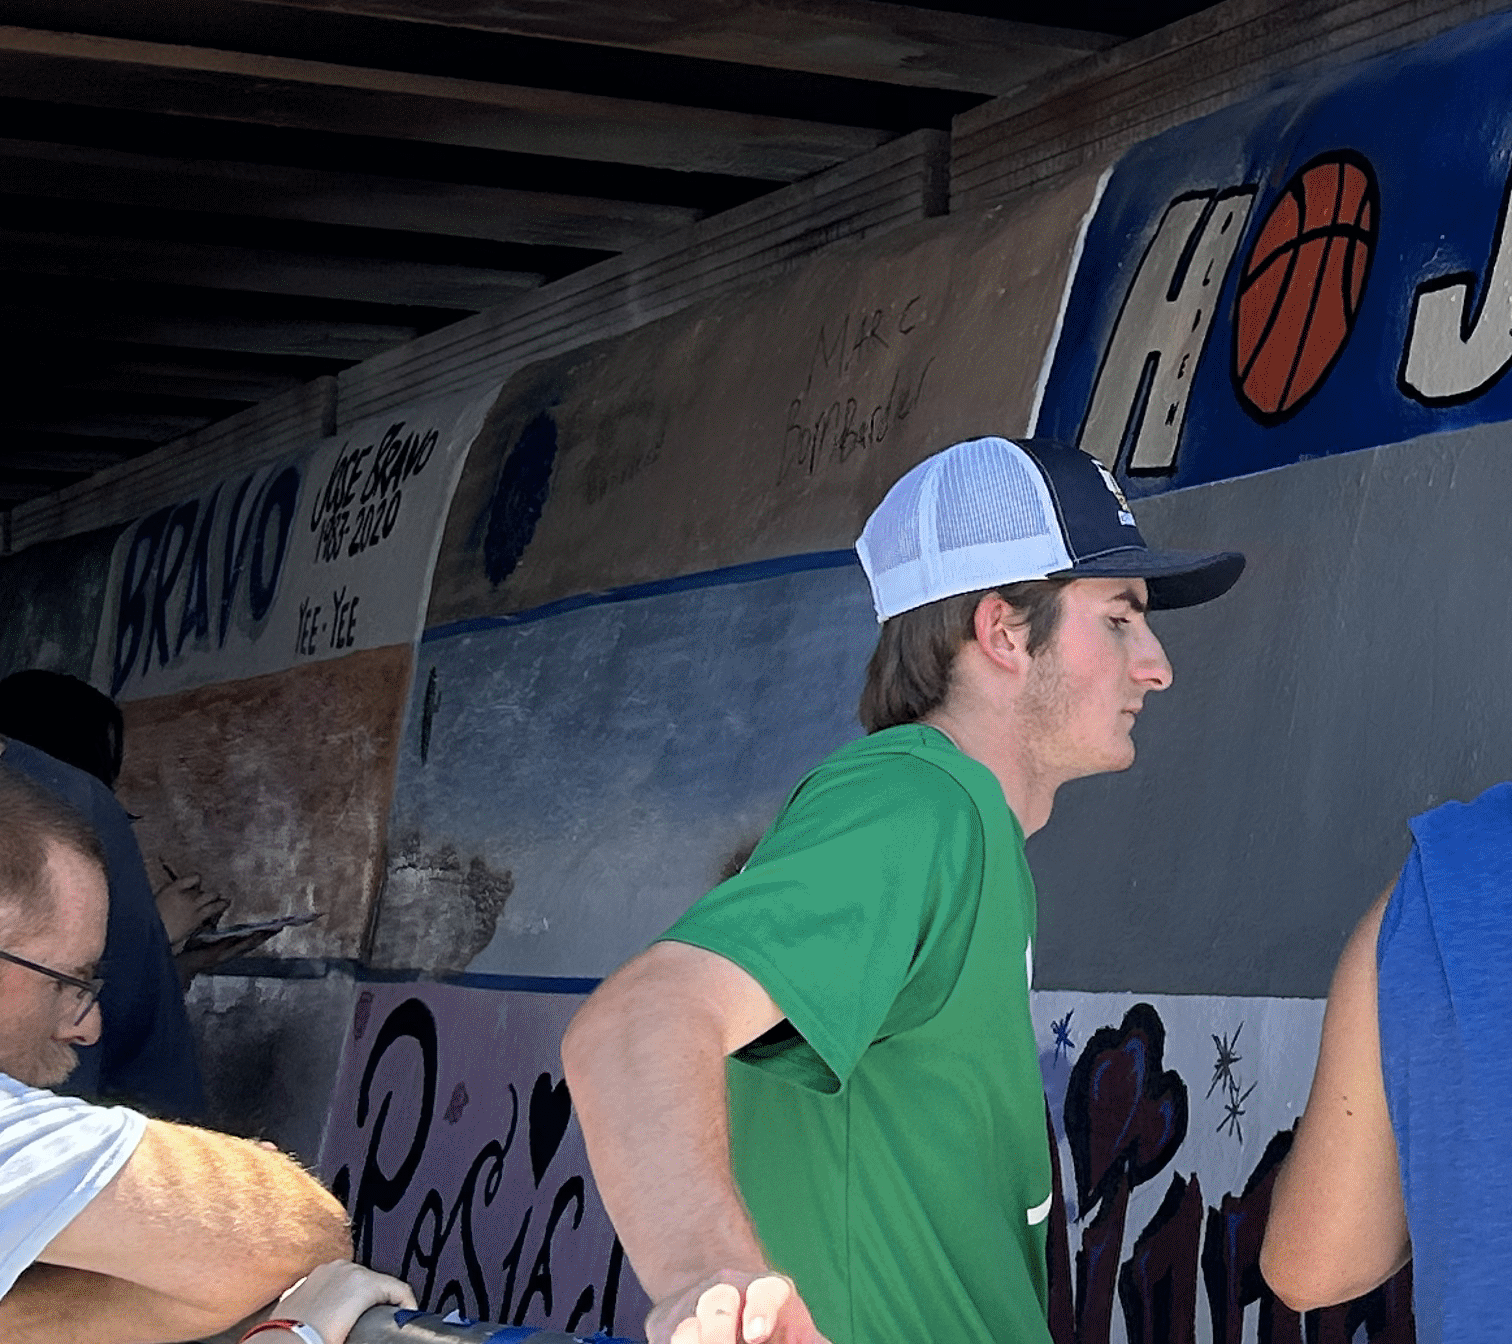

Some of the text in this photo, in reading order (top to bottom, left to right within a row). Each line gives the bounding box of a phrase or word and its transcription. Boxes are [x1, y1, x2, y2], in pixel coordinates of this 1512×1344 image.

[311, 422, 438, 533] JOSE BRAVO
[111, 465, 300, 700] BRAVO
